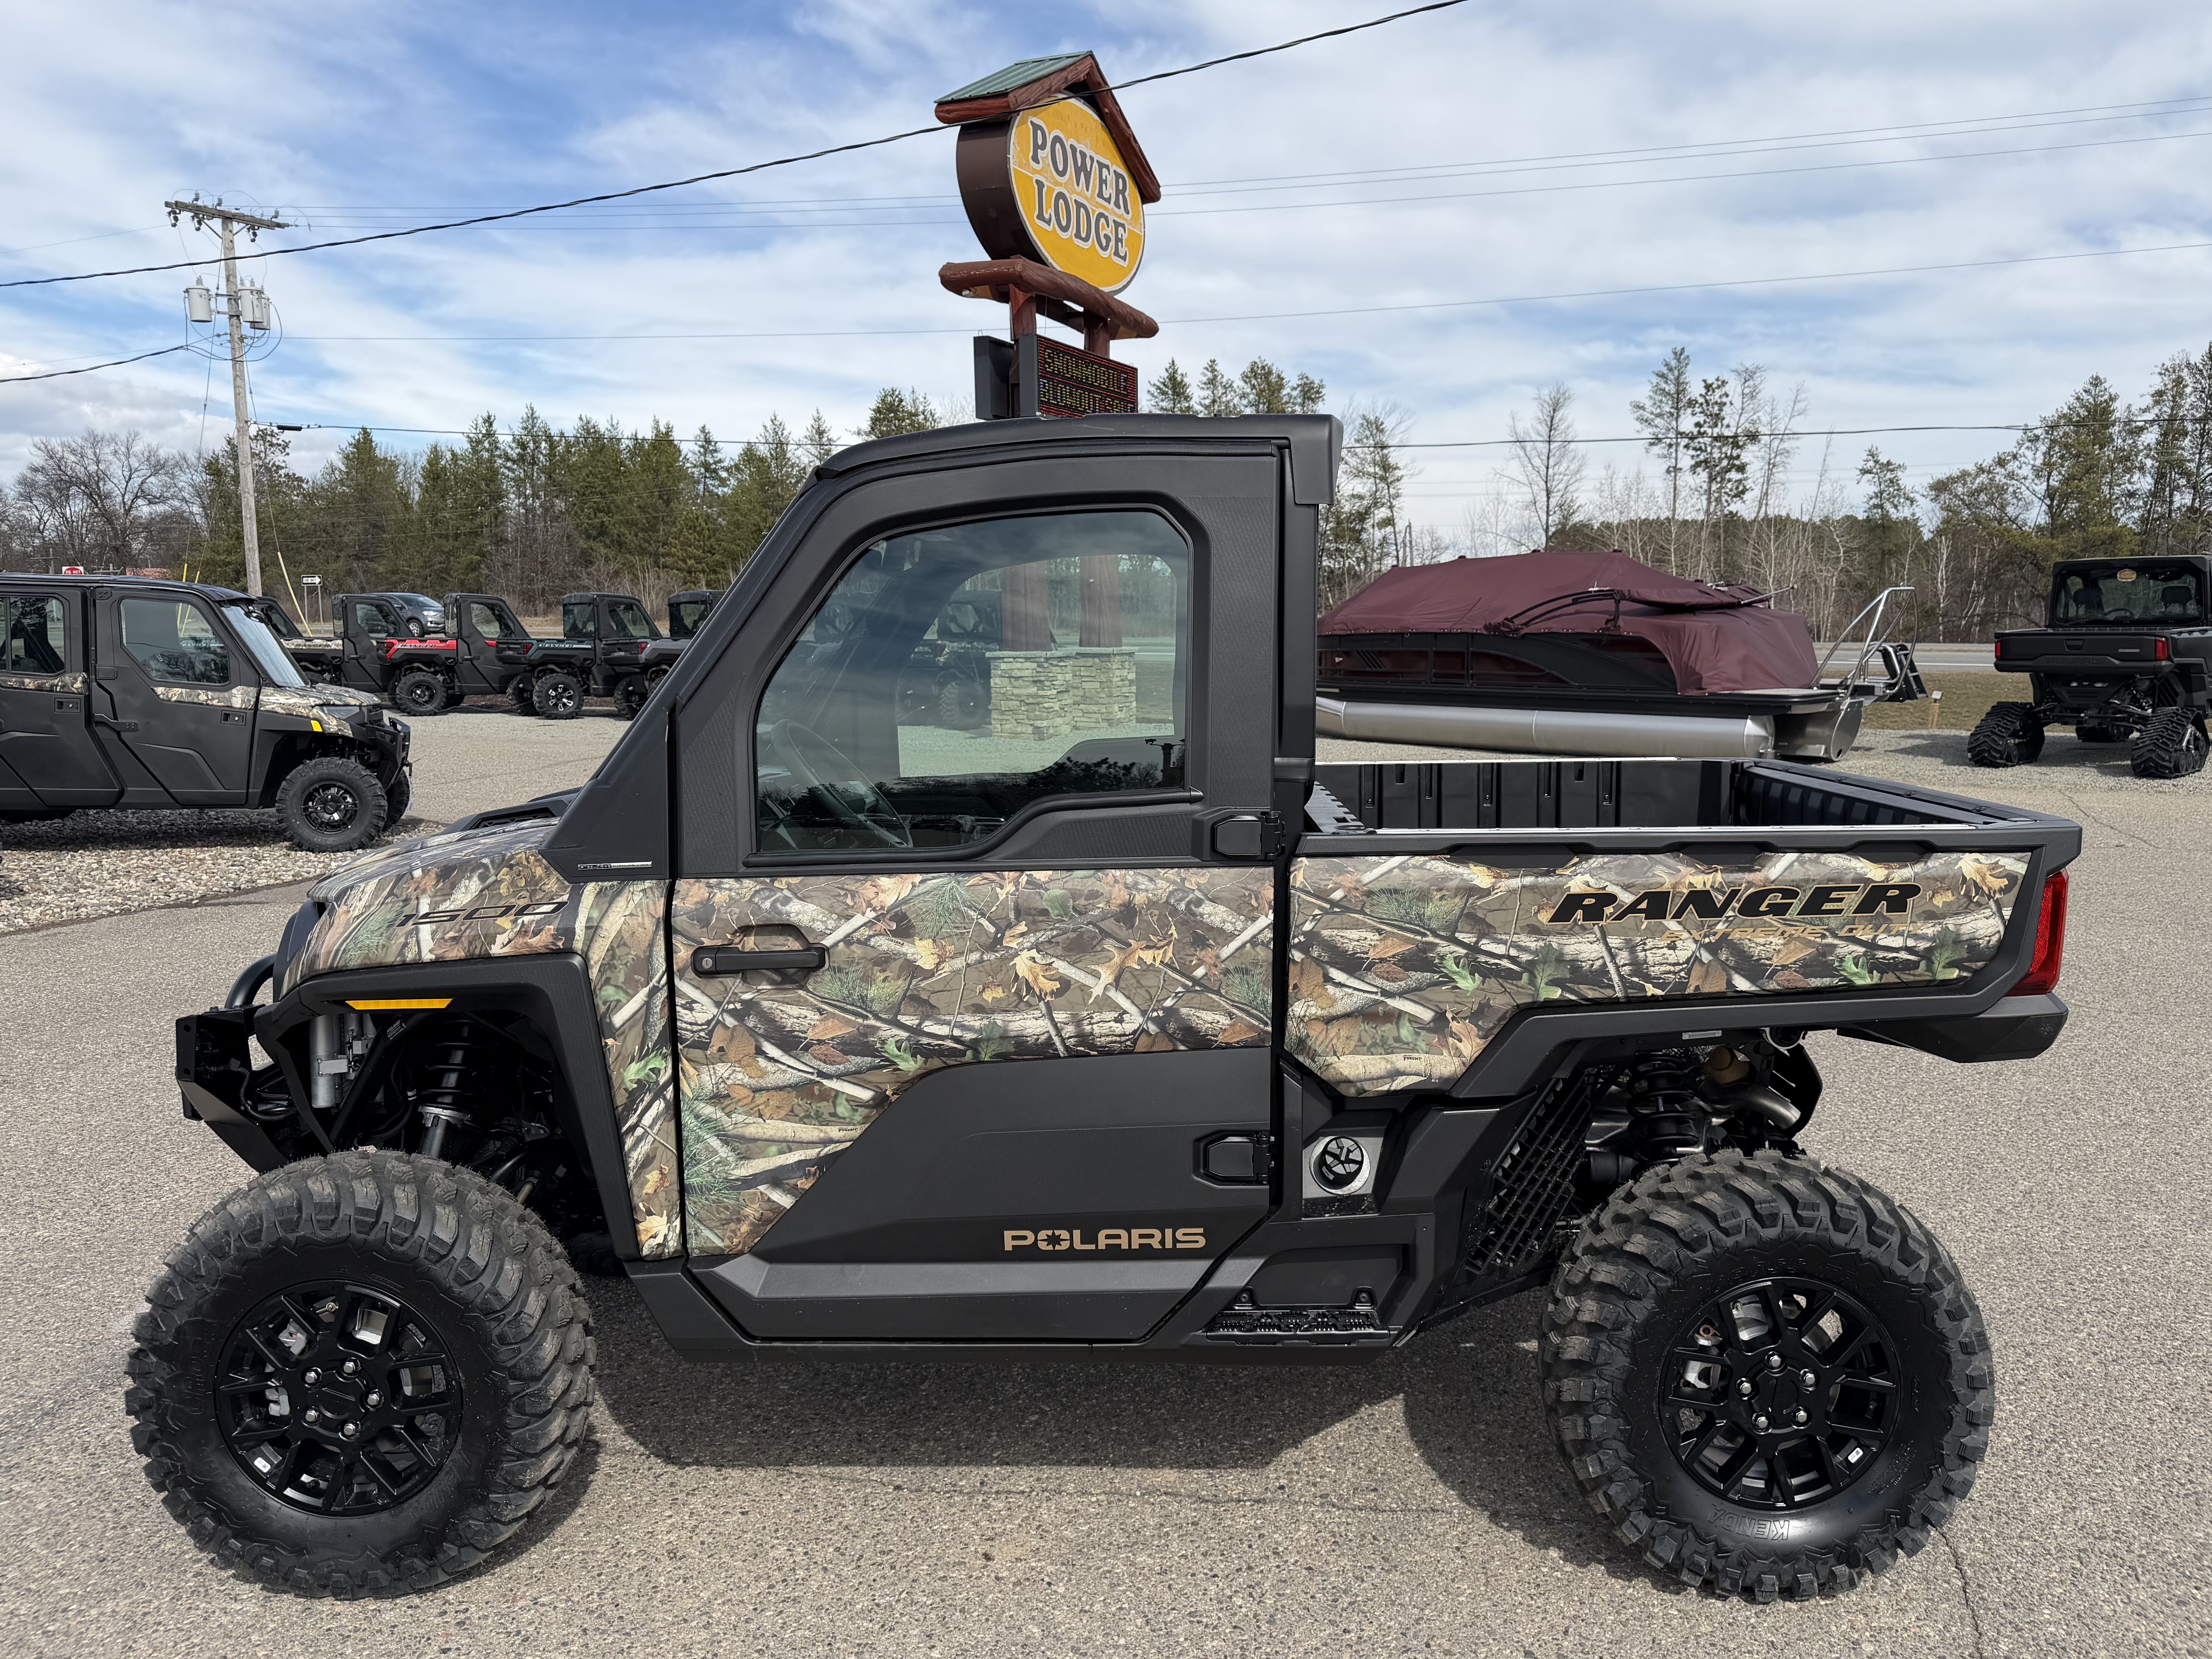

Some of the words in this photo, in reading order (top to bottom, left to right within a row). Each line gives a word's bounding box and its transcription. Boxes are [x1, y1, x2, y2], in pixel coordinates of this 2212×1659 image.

[1029, 119, 1130, 216] POWER
[1034, 178, 1128, 263] LODGE
[1044, 349, 1127, 394] SNOWMOBILE
[396, 900, 569, 927] 1500
[1547, 882, 1923, 925] RANGER
[1660, 925, 1829, 942] EXTREME
[1838, 922, 1925, 937] DUTY
[1004, 1228, 1206, 1251] POLARIS
[1707, 1503, 1790, 1541] KENDA
